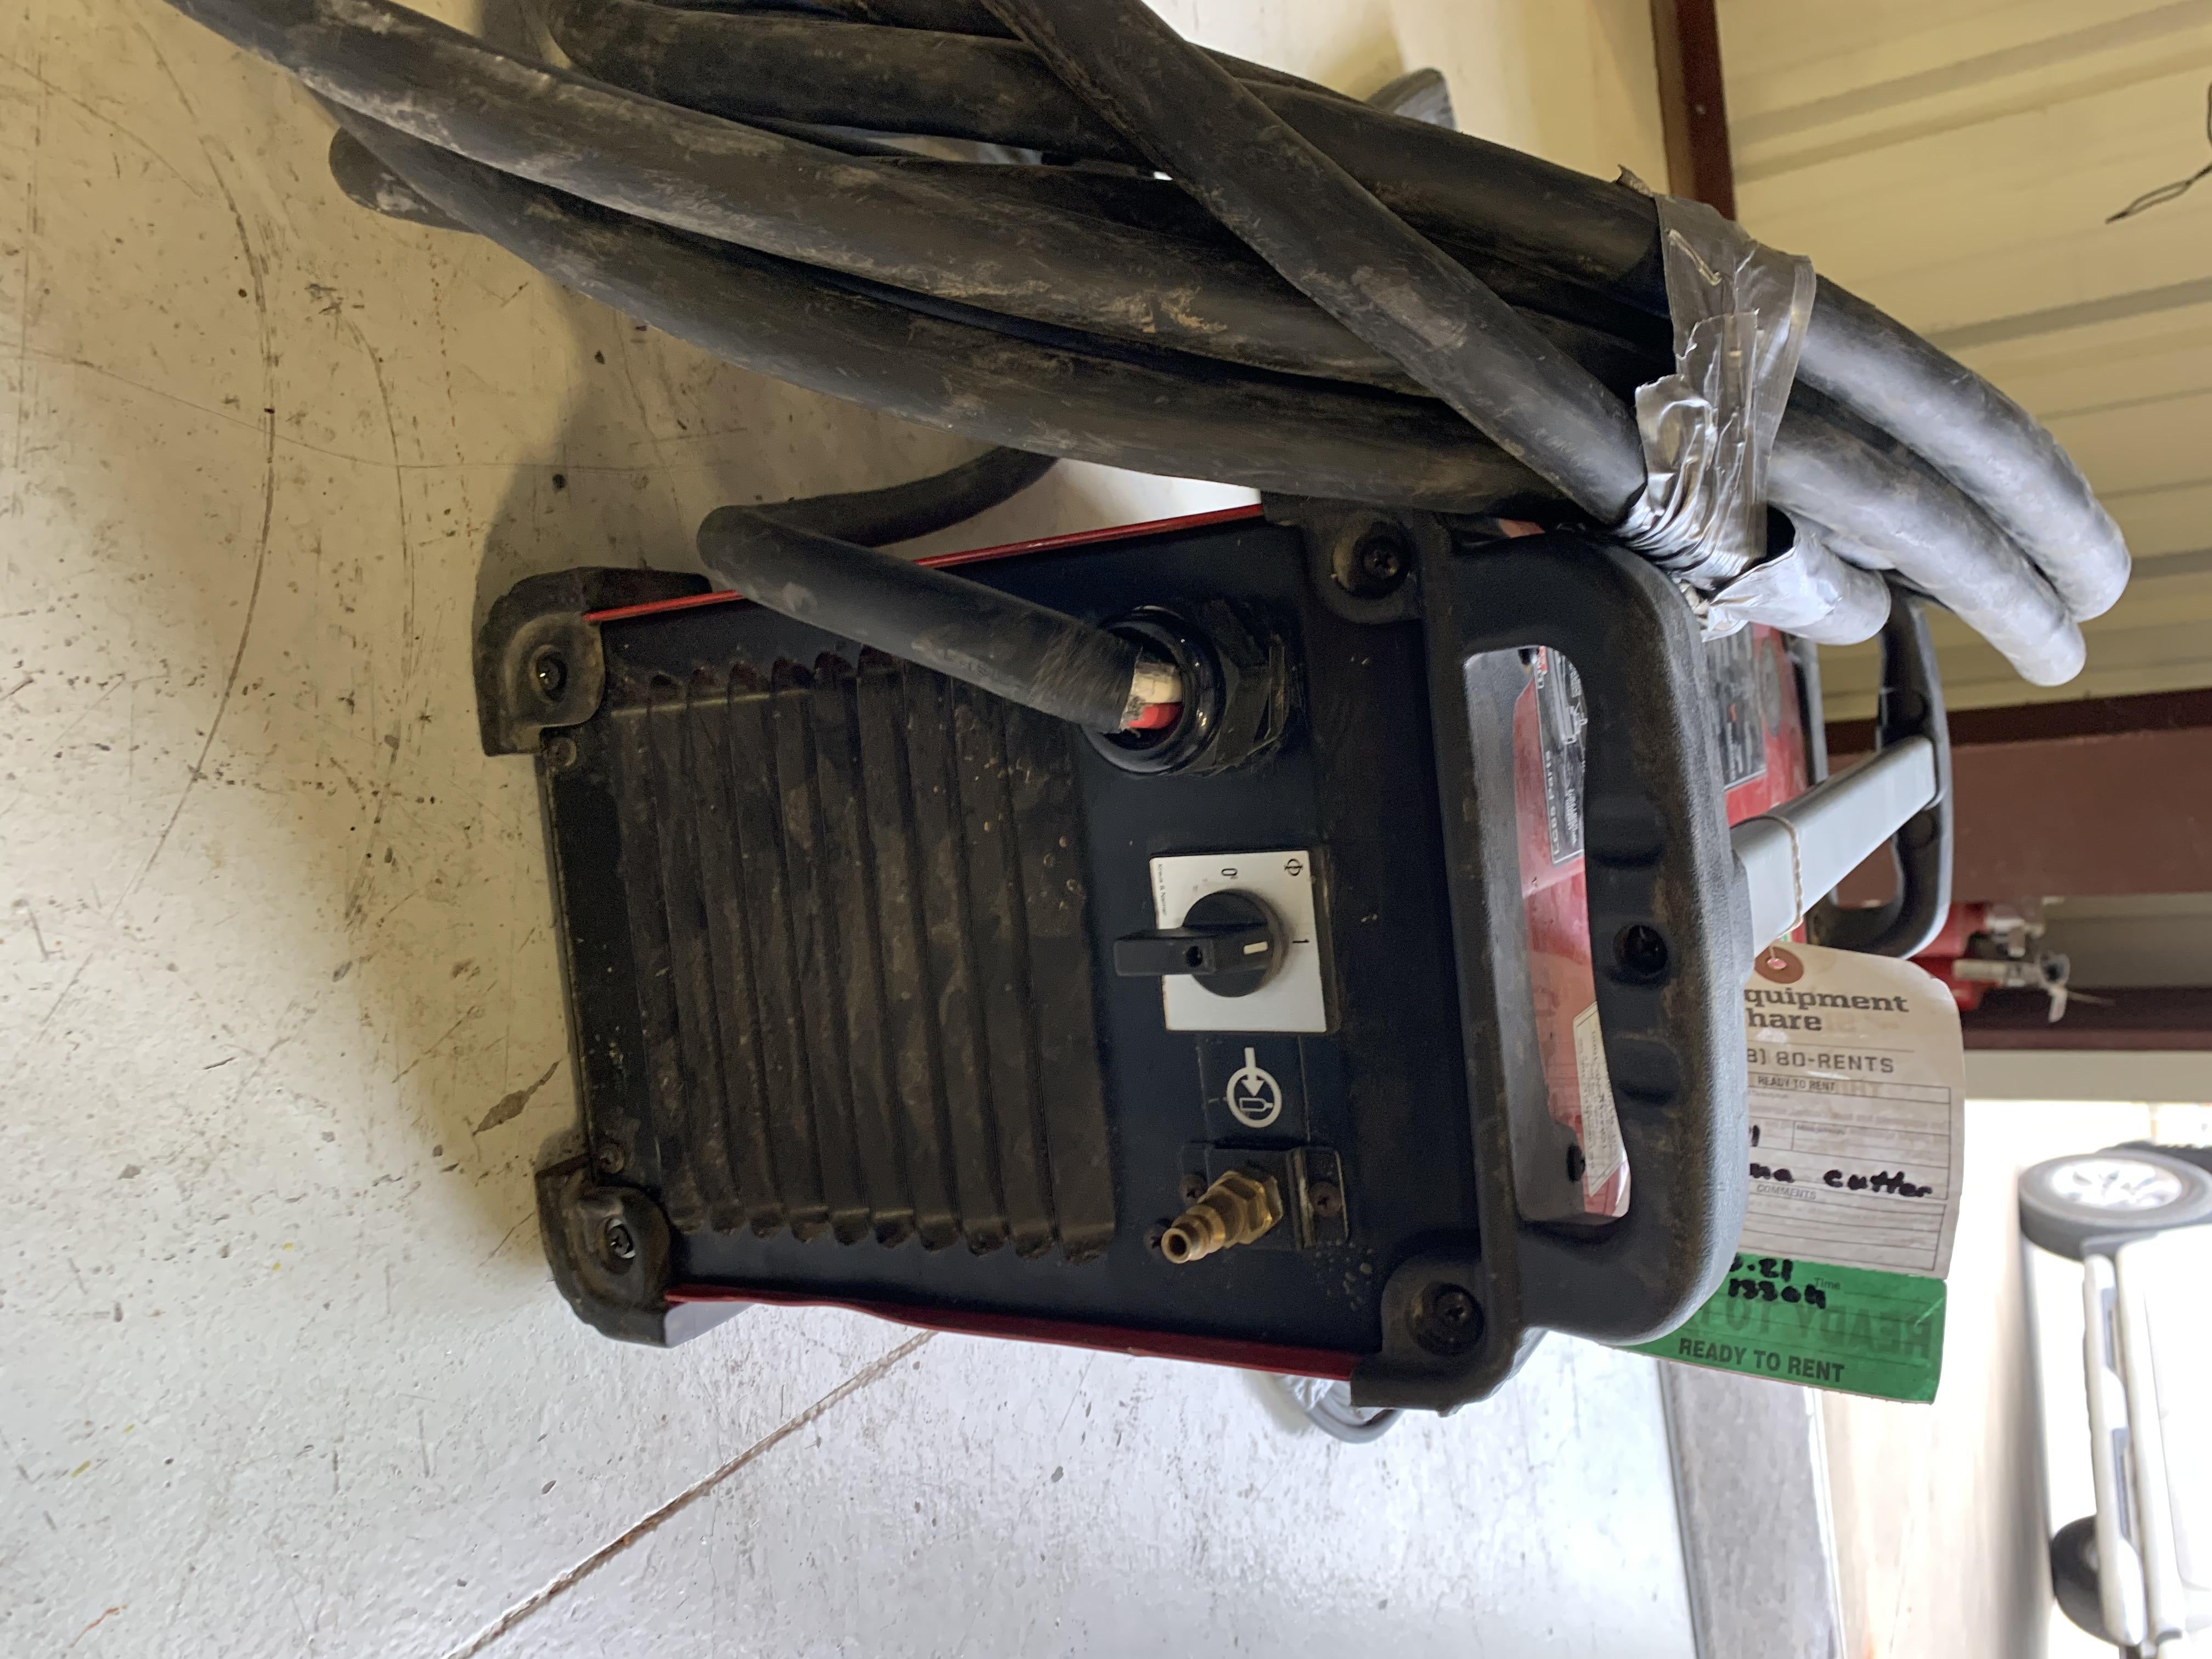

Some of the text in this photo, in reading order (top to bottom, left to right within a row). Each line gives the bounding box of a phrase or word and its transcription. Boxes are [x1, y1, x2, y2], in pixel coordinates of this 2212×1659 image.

[1221, 868, 1238, 876] 0
[1744, 987, 1909, 1012] quipment
[1746, 1007, 1822, 1031] hare
[1776, 1050, 1895, 1074] 80-RENTS
[1758, 1075, 1836, 1091] READY TO RENT
[1757, 1183, 1817, 1200] COMMENTS
[1814, 1277, 1841, 1290] Time
[1679, 1337, 1845, 1383] READY TO RENT
